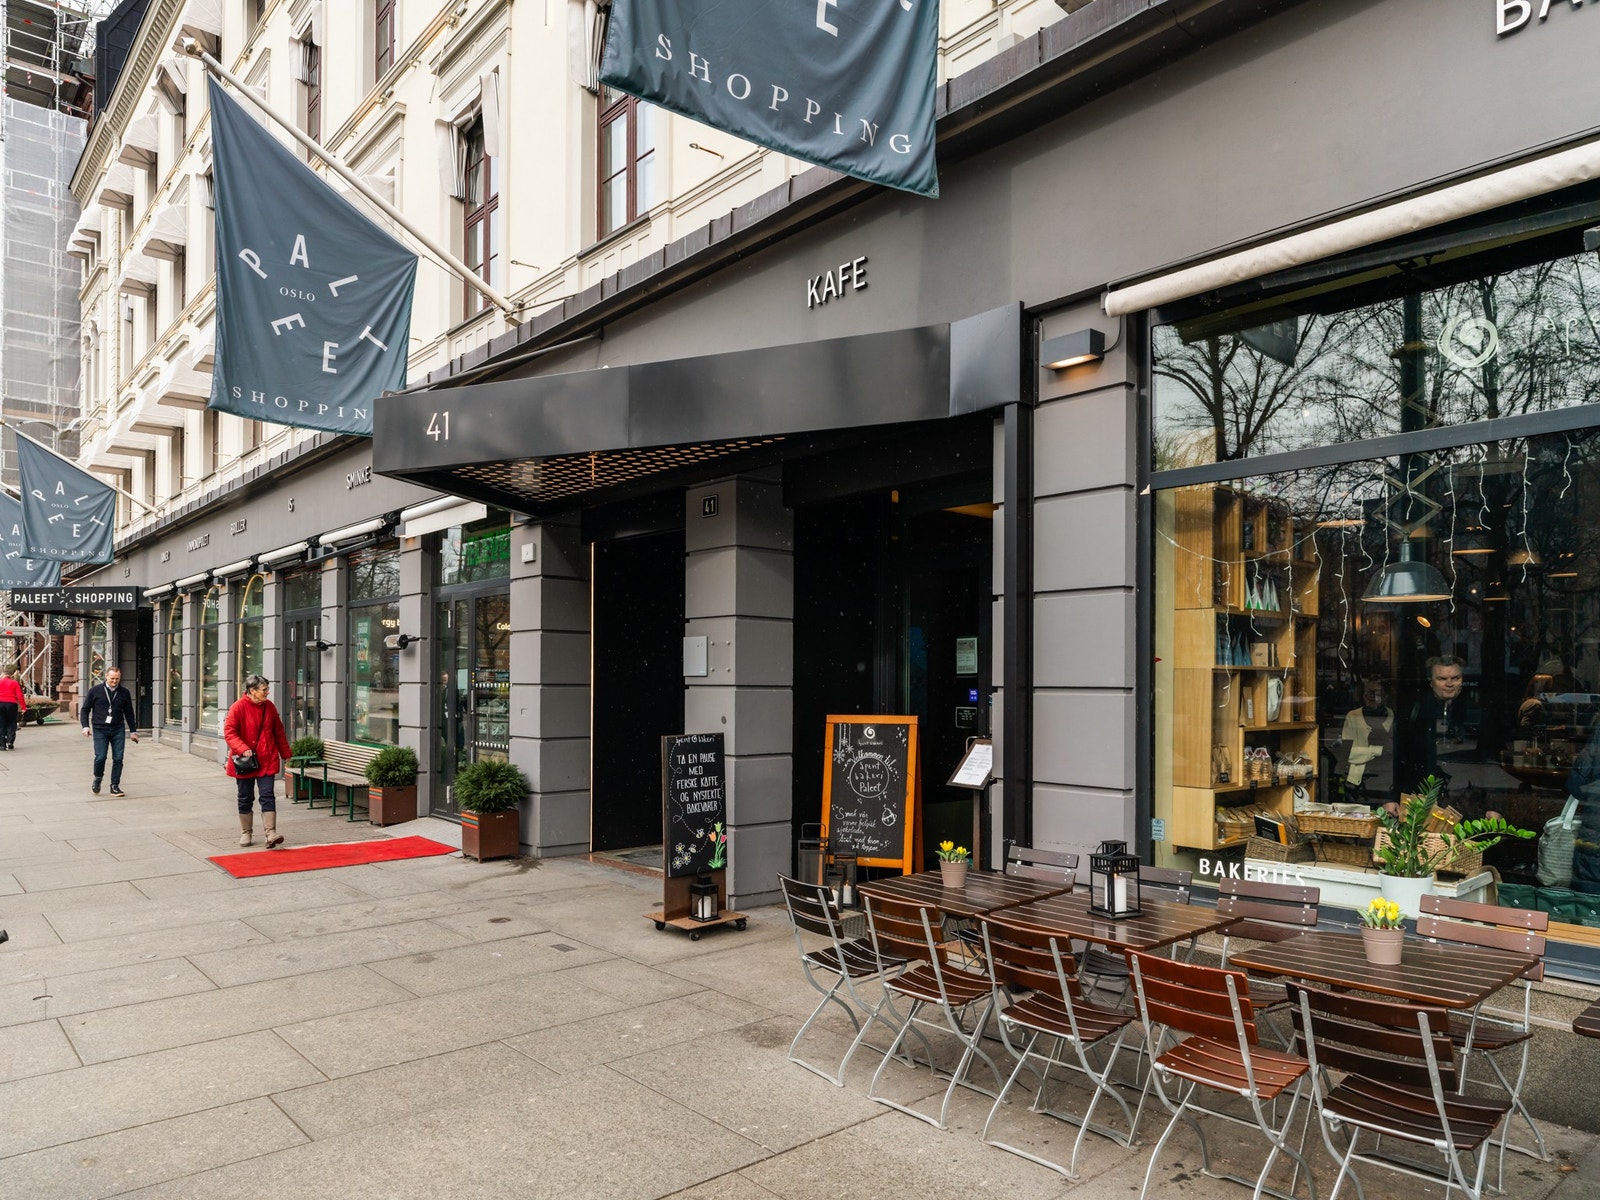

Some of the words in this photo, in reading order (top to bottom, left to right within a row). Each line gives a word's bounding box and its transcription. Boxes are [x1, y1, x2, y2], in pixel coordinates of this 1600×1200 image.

[656, 33, 912, 154] SHOPPING
[808, 256, 866, 308] KAFE
[279, 287, 316, 302] OSLO
[232, 386, 368, 420] SHOPPIN
[426, 411, 449, 442] 41
[346, 466, 371, 490] SMINKE
[704, 499, 714, 513] 41
[30, 546, 105, 558] SHOPPING
[14, 593, 54, 604] PALEET
[75, 592, 133, 604] SHOPPING
[677, 754, 686, 765] TA
[688, 753, 698, 764] EN
[700, 752, 716, 763] PAUSE
[689, 765, 703, 775] MED
[677, 777, 698, 790] FERSKE
[700, 775, 718, 788] KAFFE
[859, 782, 882, 793] Paleet
[680, 791, 689, 803] OG
[693, 788, 721, 802] NYSTEKTE
[686, 801, 718, 814] BAKEVARER
[1199, 858, 1306, 887] BAKERIES
